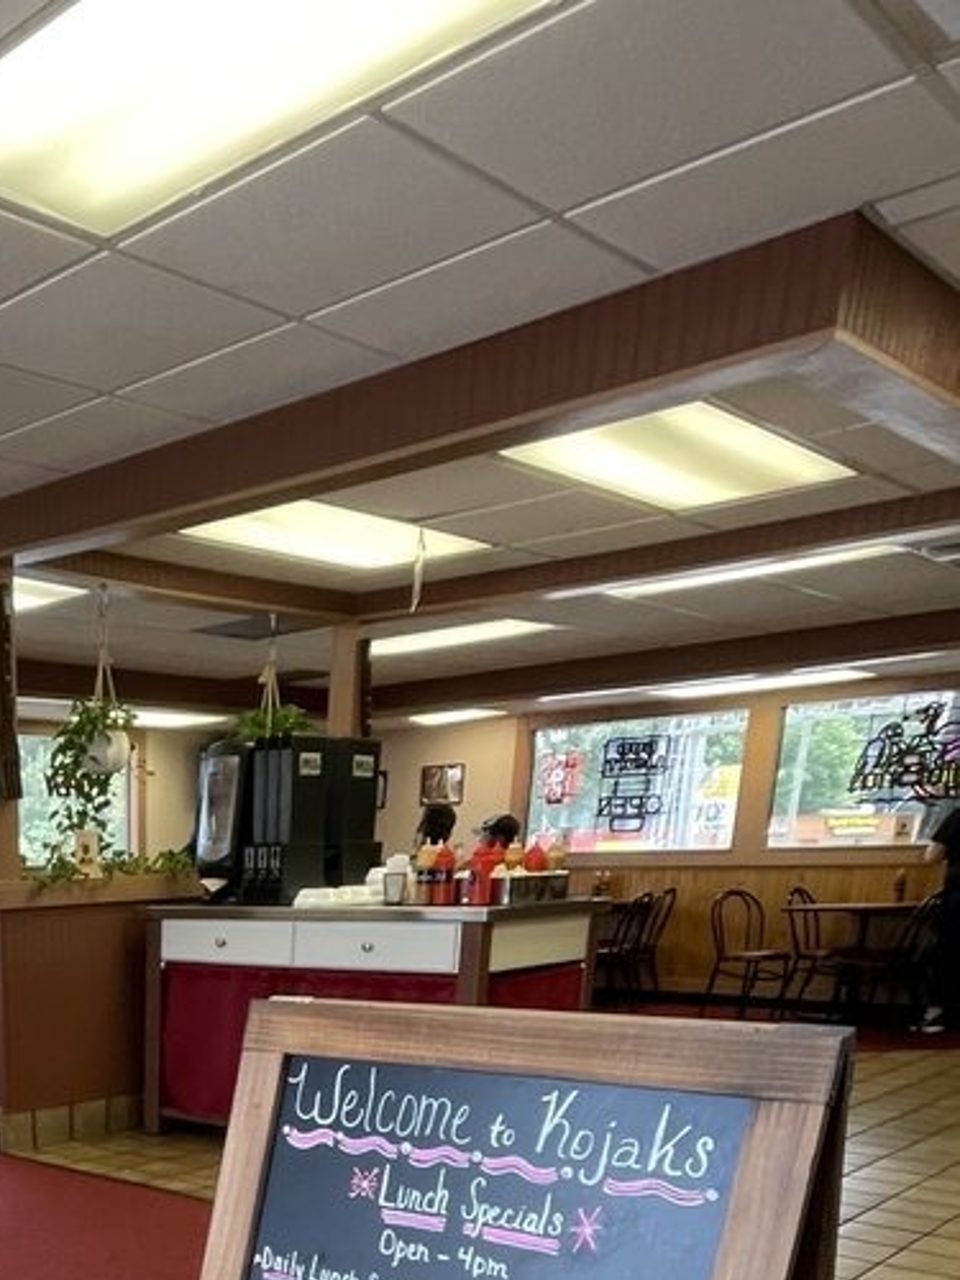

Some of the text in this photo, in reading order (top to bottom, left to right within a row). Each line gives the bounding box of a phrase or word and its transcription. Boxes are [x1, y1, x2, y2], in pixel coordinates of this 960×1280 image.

[288, 1063, 716, 1186] Welcome to Kojaks
[379, 1164, 565, 1238] Lunch Specials
[379, 1229, 429, 1268] Open
[457, 1245, 510, 1280] 4pm
